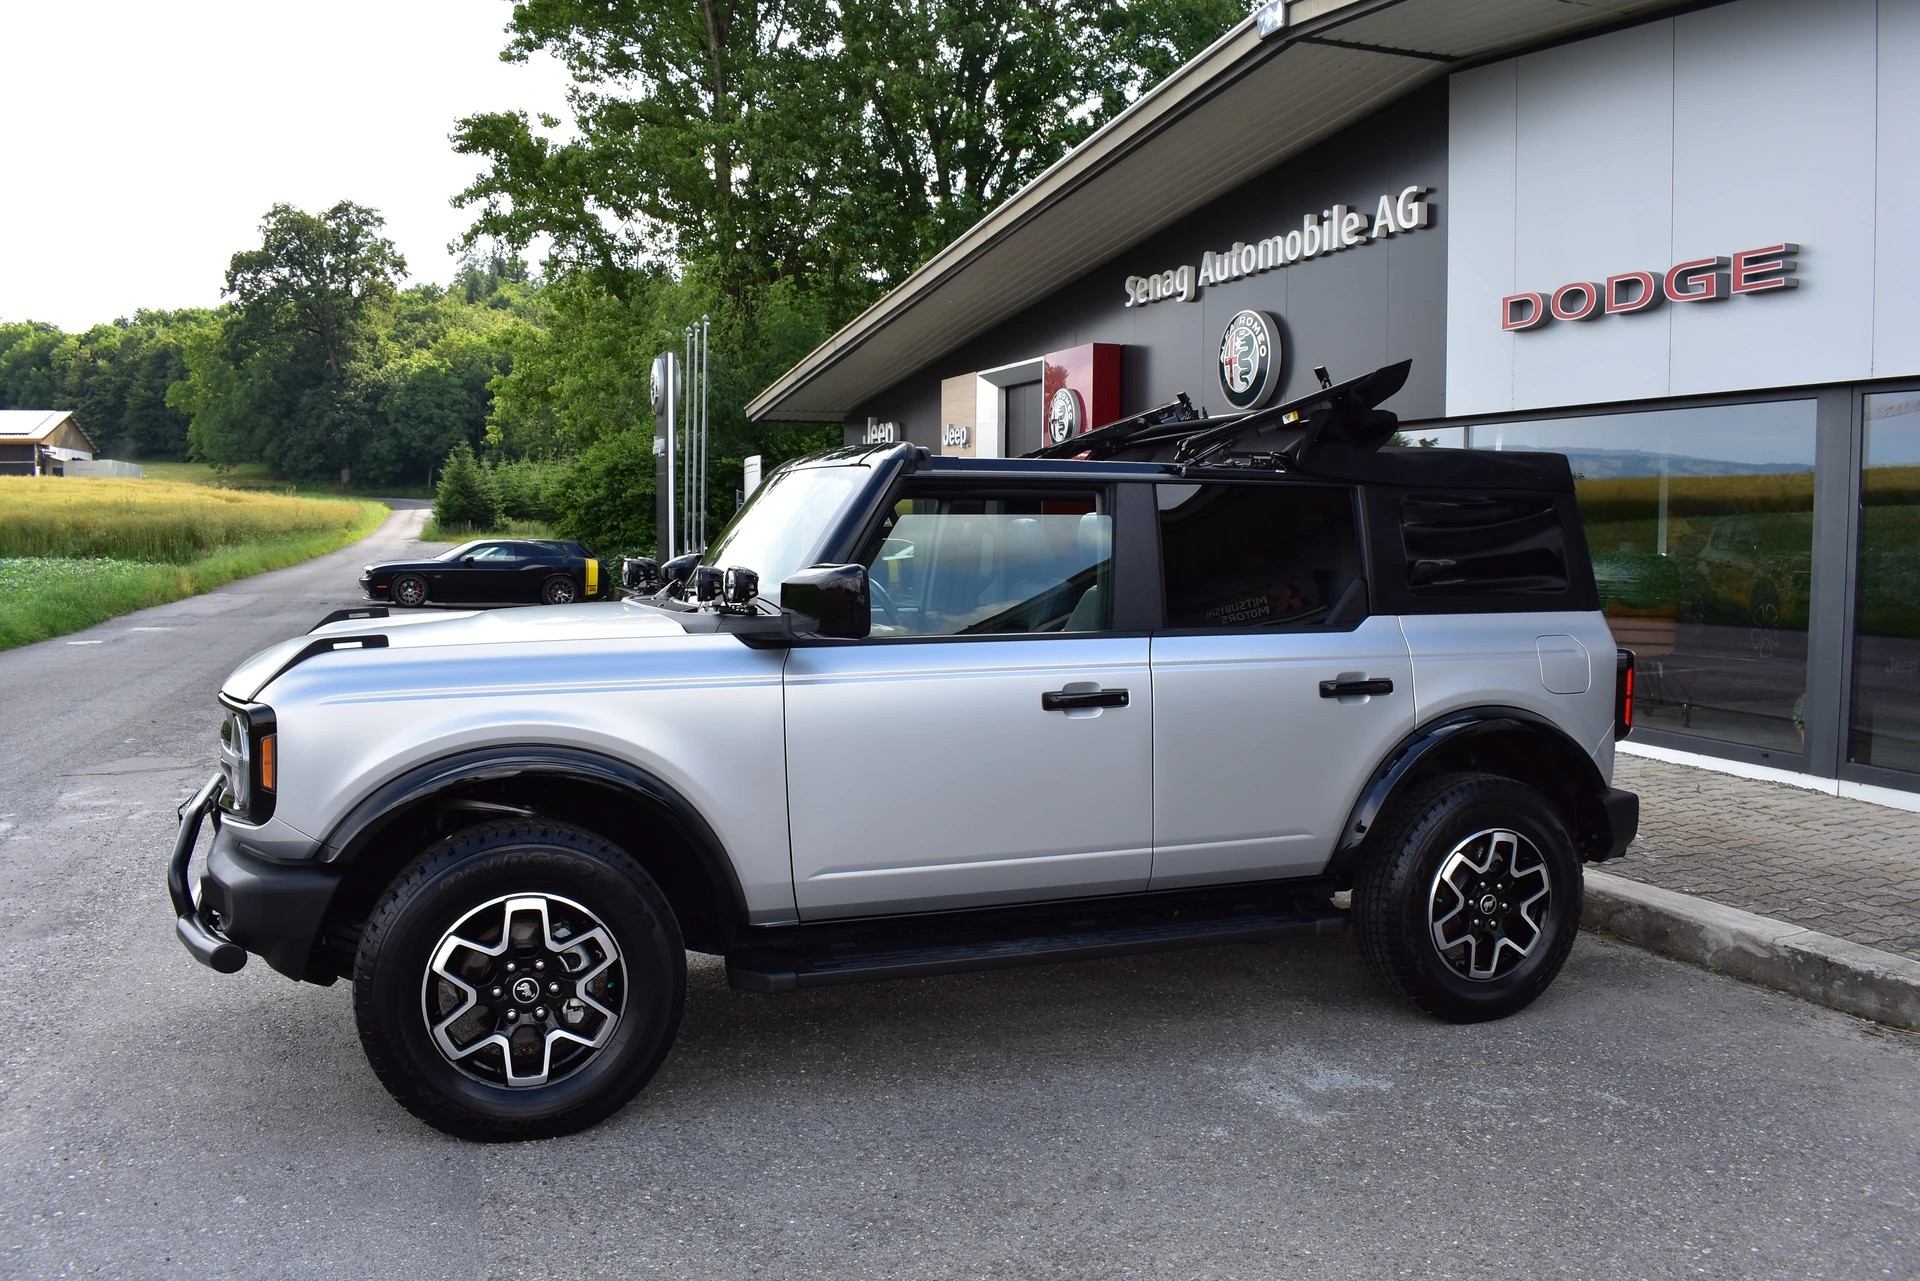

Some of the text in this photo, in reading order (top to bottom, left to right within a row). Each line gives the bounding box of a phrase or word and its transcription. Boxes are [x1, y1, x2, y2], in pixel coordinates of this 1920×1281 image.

[1124, 185, 1427, 307] Senag Automobile AG
[1502, 242, 1798, 332] DODGE
[1239, 316, 1268, 358] ROMEO
[863, 417, 897, 445] Jeep
[943, 423, 970, 449] Jeep
[1884, 656, 1918, 677] Jeep
